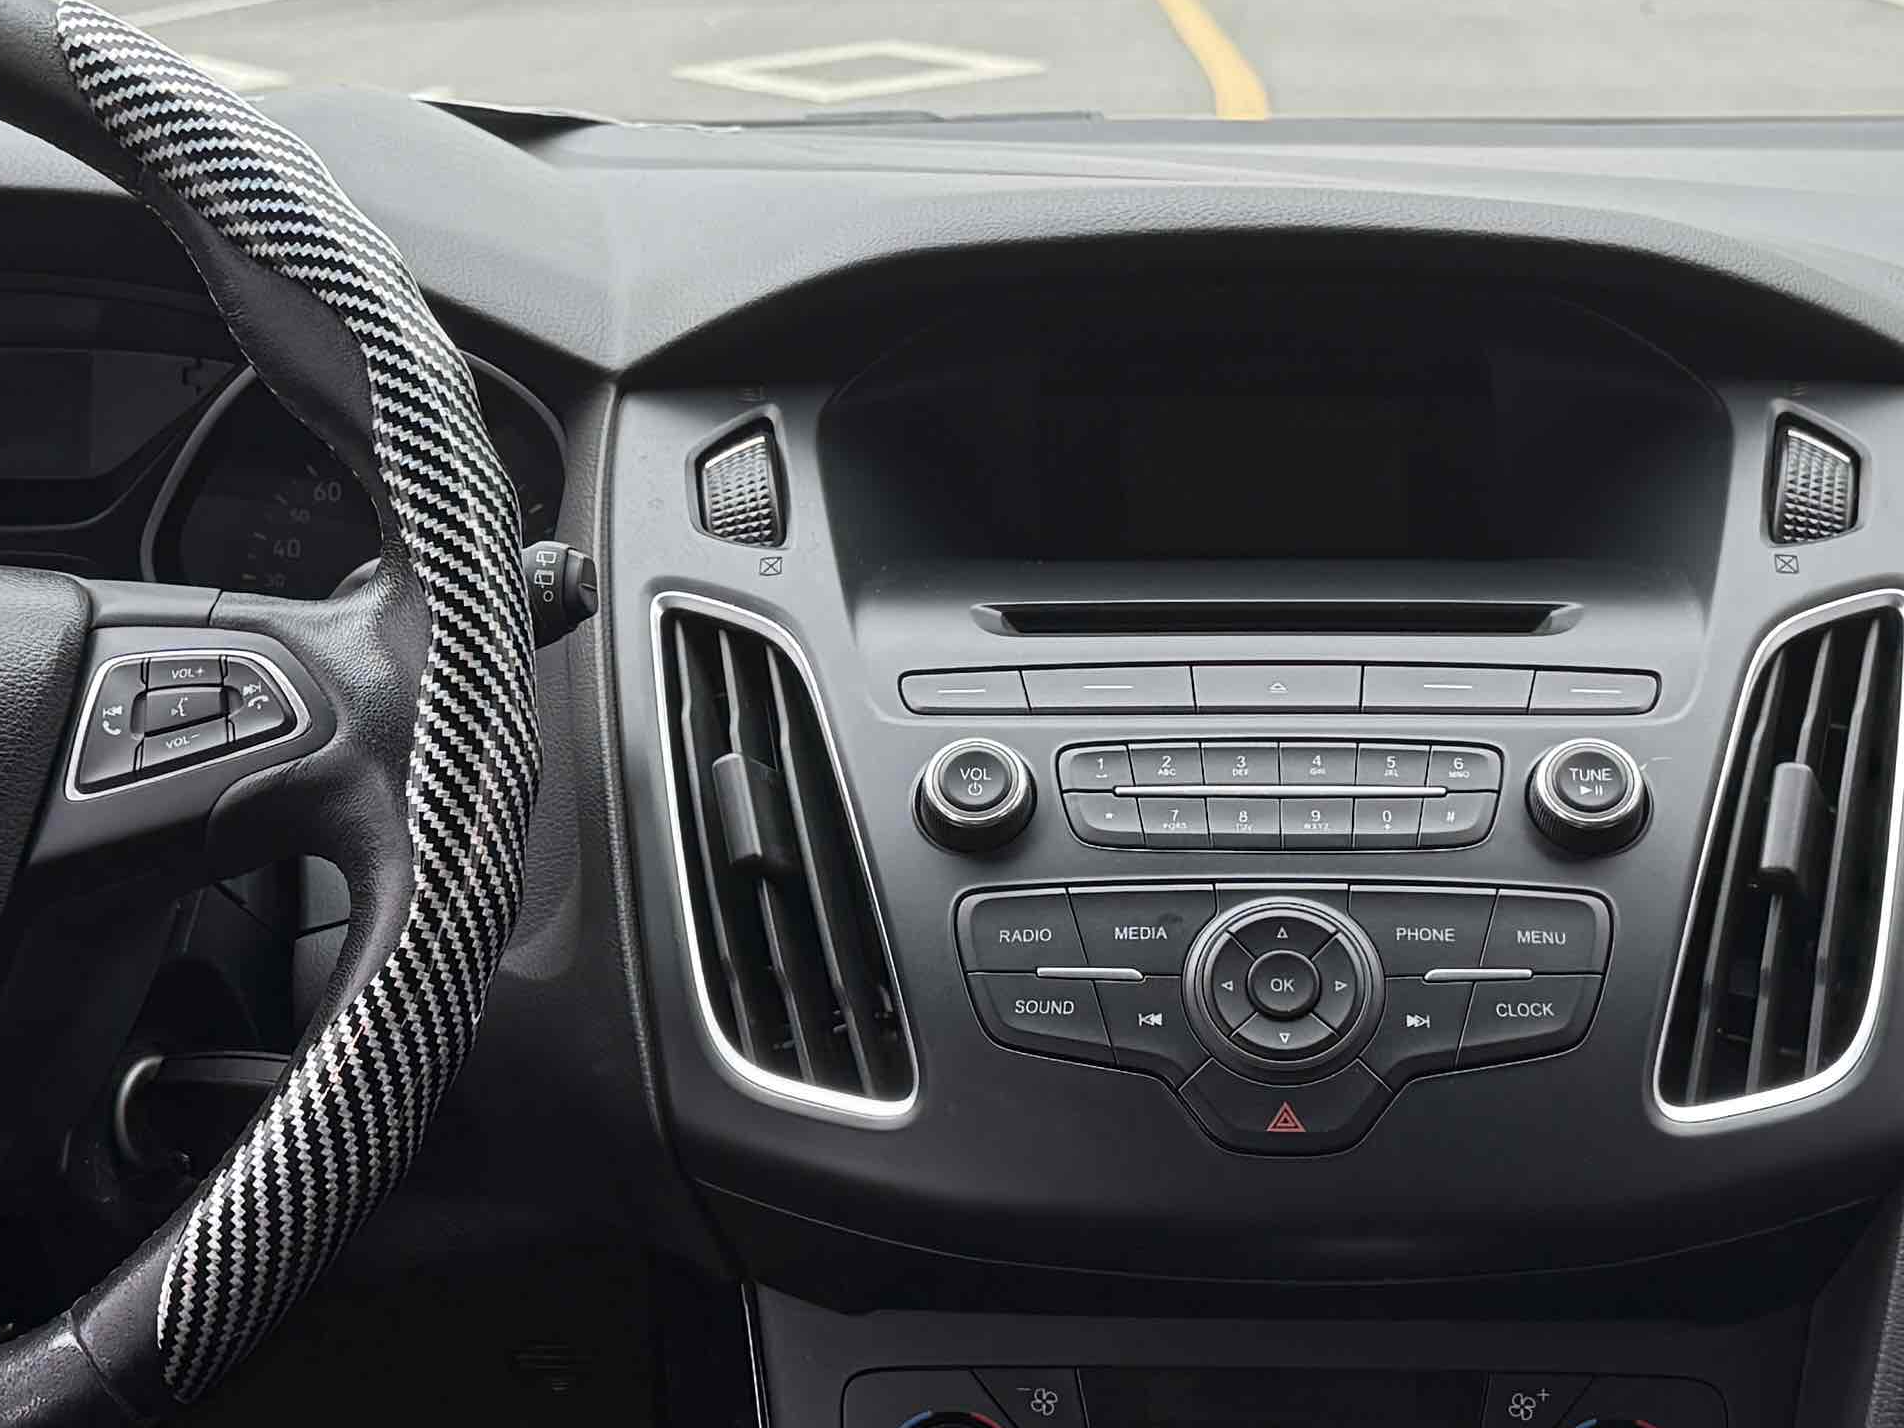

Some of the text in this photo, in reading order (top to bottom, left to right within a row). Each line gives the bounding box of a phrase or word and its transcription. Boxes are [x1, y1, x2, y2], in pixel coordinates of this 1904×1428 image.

[313, 481, 342, 501] 60
[272, 538, 301, 559] 40
[1097, 757, 1104, 769] 1
[1161, 755, 1172, 768] 2
[1236, 755, 1247, 768] 3
[1311, 755, 1321, 767] 4
[1386, 756, 1396, 768] 5
[1454, 757, 1464, 769] 6
[960, 767, 992, 782] VOL
[1568, 767, 1613, 782] TUNE
[1169, 809, 1180, 821] 7
[1239, 810, 1249, 822] 8
[1310, 810, 1321, 822] 9
[1382, 810, 1392, 823] 0
[999, 928, 1053, 944] RADIO
[1114, 926, 1168, 940] MEDIA
[1396, 927, 1456, 942] PHONE
[1517, 930, 1567, 945] MENU
[1271, 978, 1295, 993] OK
[1014, 1000, 1075, 1015] SOUND
[1496, 1002, 1555, 1017] CLOCK
